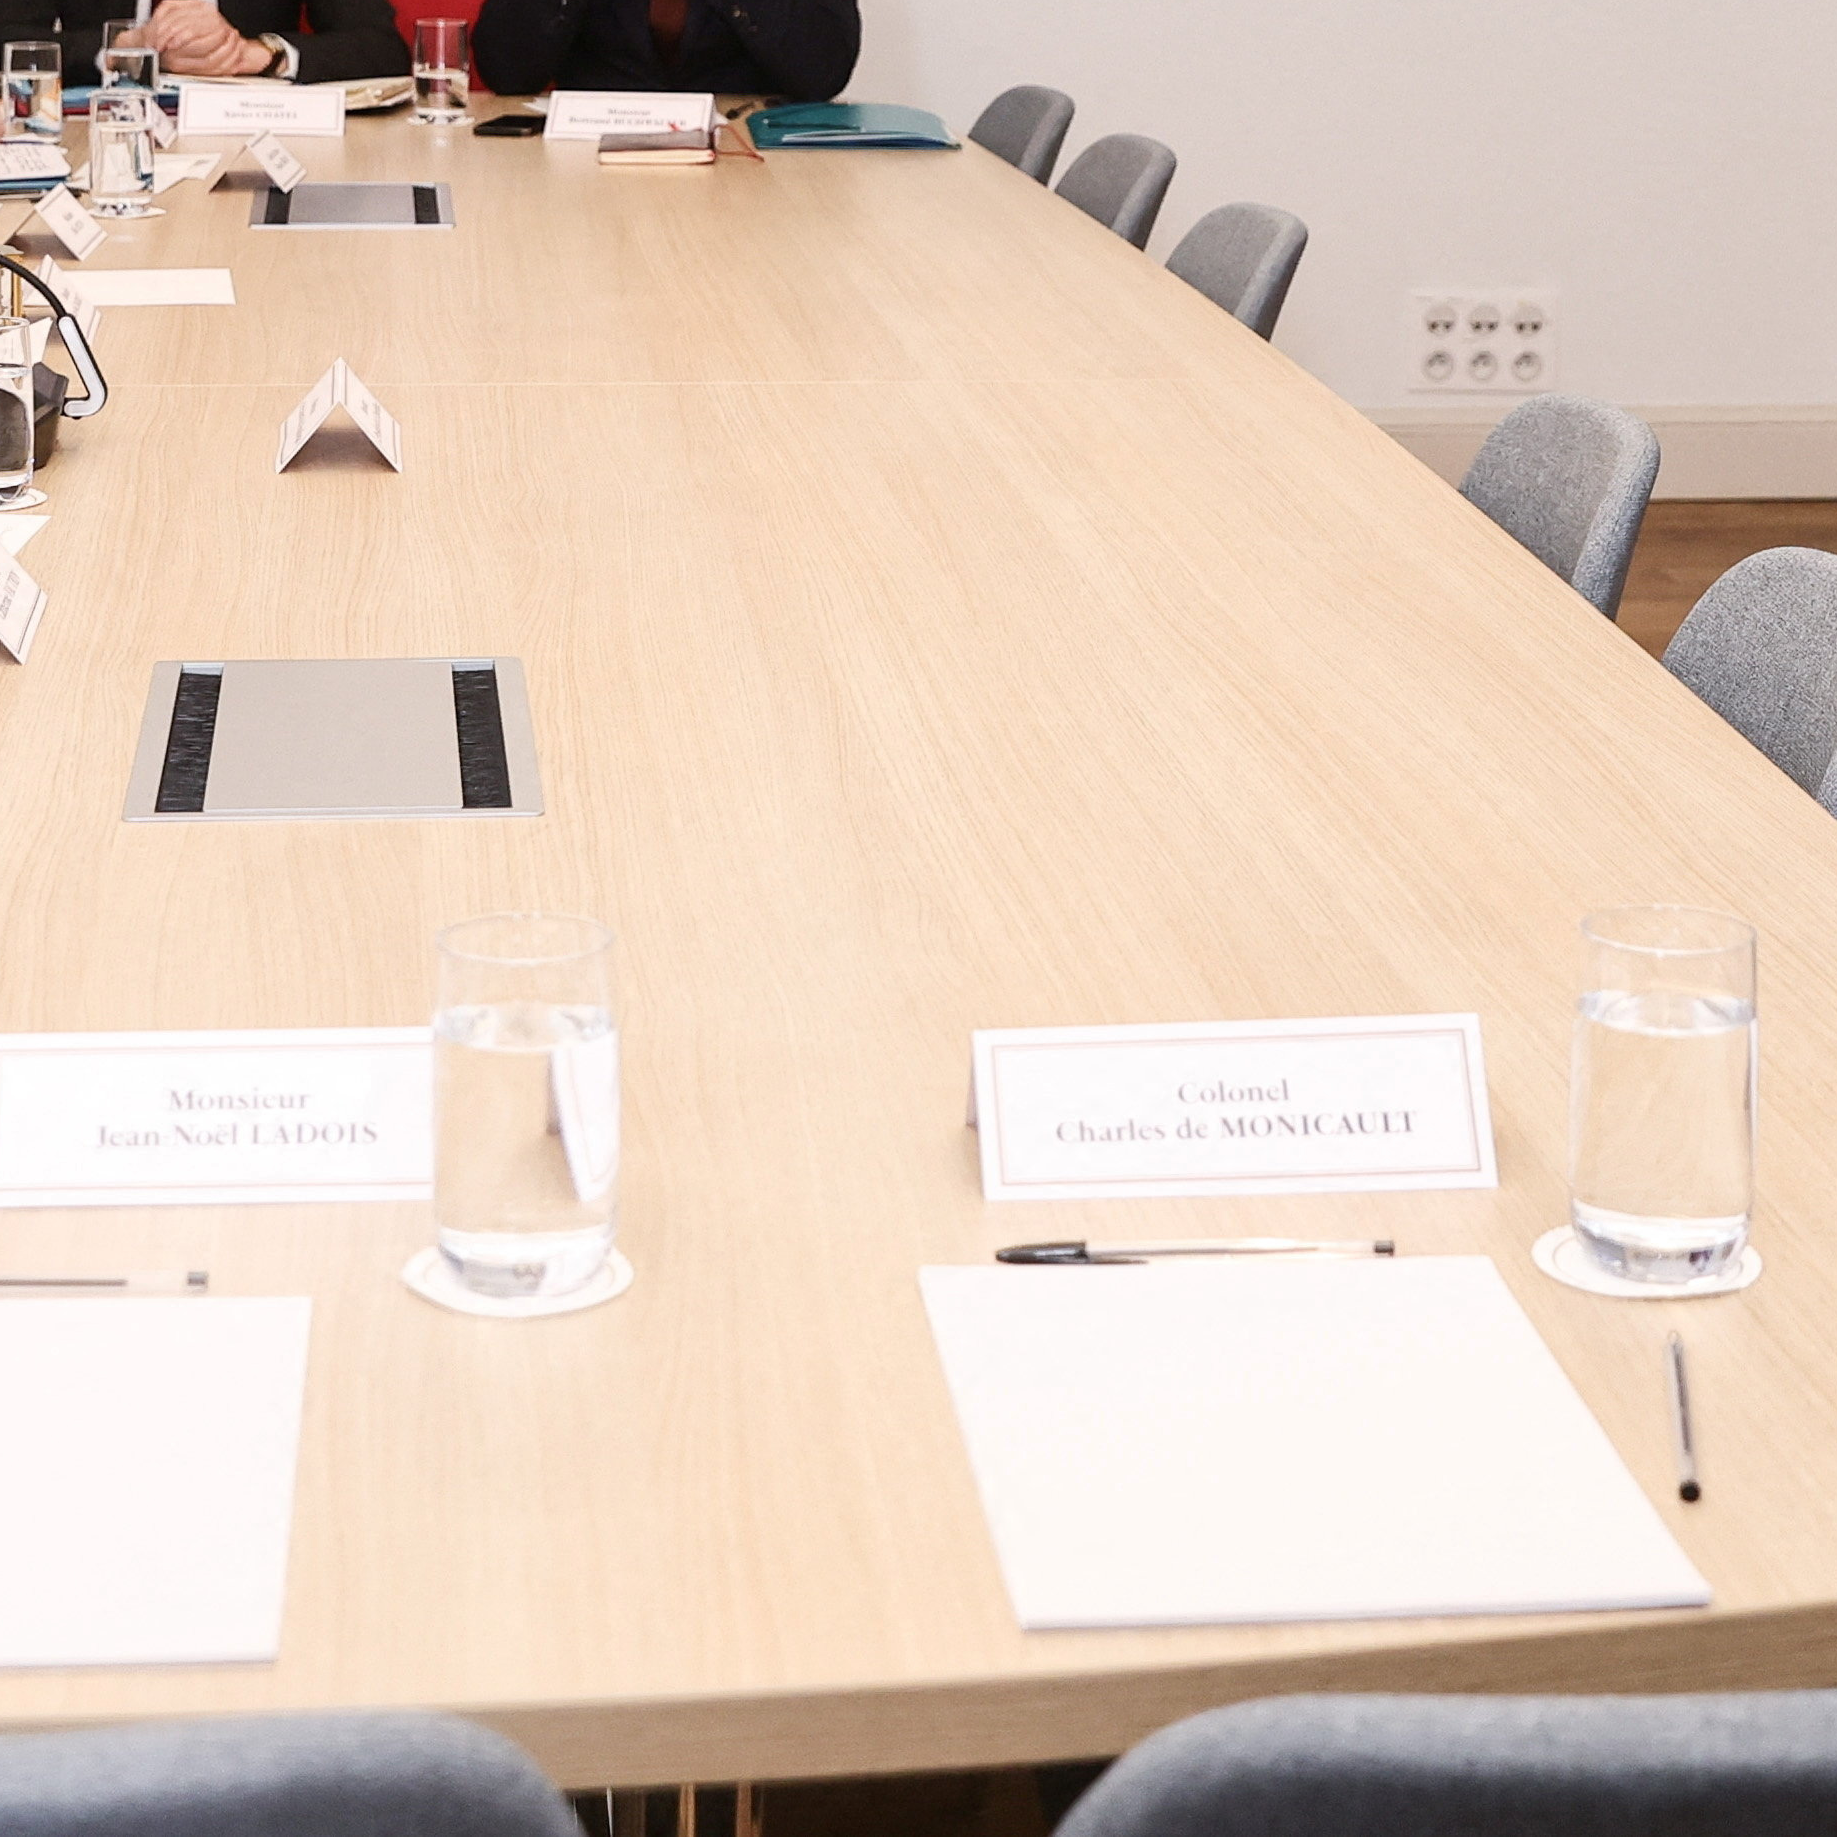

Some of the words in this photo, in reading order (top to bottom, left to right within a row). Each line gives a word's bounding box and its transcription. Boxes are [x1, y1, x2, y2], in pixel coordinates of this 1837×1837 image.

[167, 1087, 311, 1111] Monsieur
[1178, 1078, 1289, 1105] Colonel
[94, 1117, 240, 1149] Jean-Noël
[250, 1119, 379, 1148] LADOIS
[1055, 1117, 1166, 1144] Charles
[1178, 1116, 1209, 1141] de
[1219, 1109, 1418, 1139] MONICAULT
